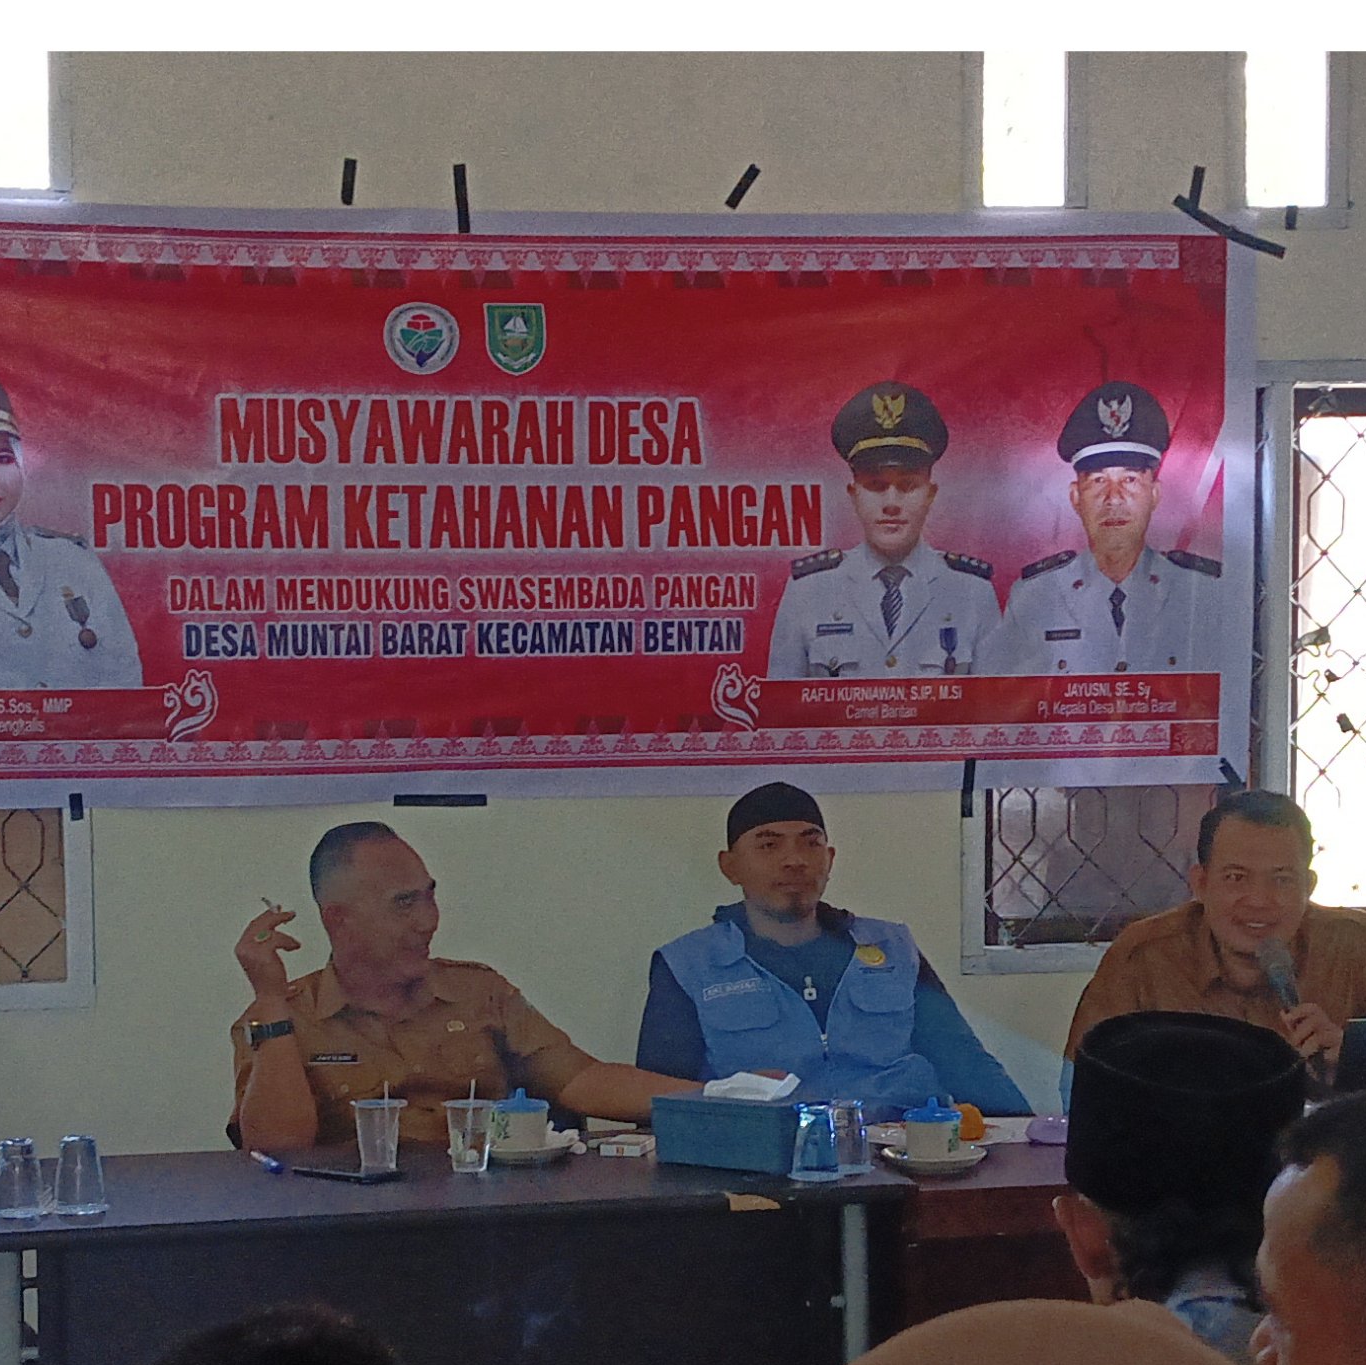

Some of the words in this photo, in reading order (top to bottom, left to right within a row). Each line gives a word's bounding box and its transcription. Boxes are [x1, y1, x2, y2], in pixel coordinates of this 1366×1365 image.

[218, 397, 574, 465] MUSYAWARAH
[587, 399, 703, 466] DESA
[91, 482, 330, 550] PROGRAM
[343, 484, 624, 550] KETAHANAN
[637, 484, 823, 549] PANGAN
[169, 578, 266, 612] DALAM
[276, 577, 449, 612] MENDUKUNG
[459, 576, 645, 611] SWASEMBADA
[654, 575, 756, 609] PANGAN
[184, 622, 258, 657] DESA
[267, 622, 371, 657] MUNTAI
[380, 622, 468, 656] BARAT
[477, 620, 634, 655] KECAMATAN
[644, 619, 743, 654] BENTAN
[802, 687, 835, 702] RAFLI
[1137, 681, 1151, 699] Sy
[42, 698, 73, 713] MMP
[1053, 700, 1086, 717] Kepala
[1089, 700, 1115, 715] Desa
[1150, 698, 1177, 713] Barat
